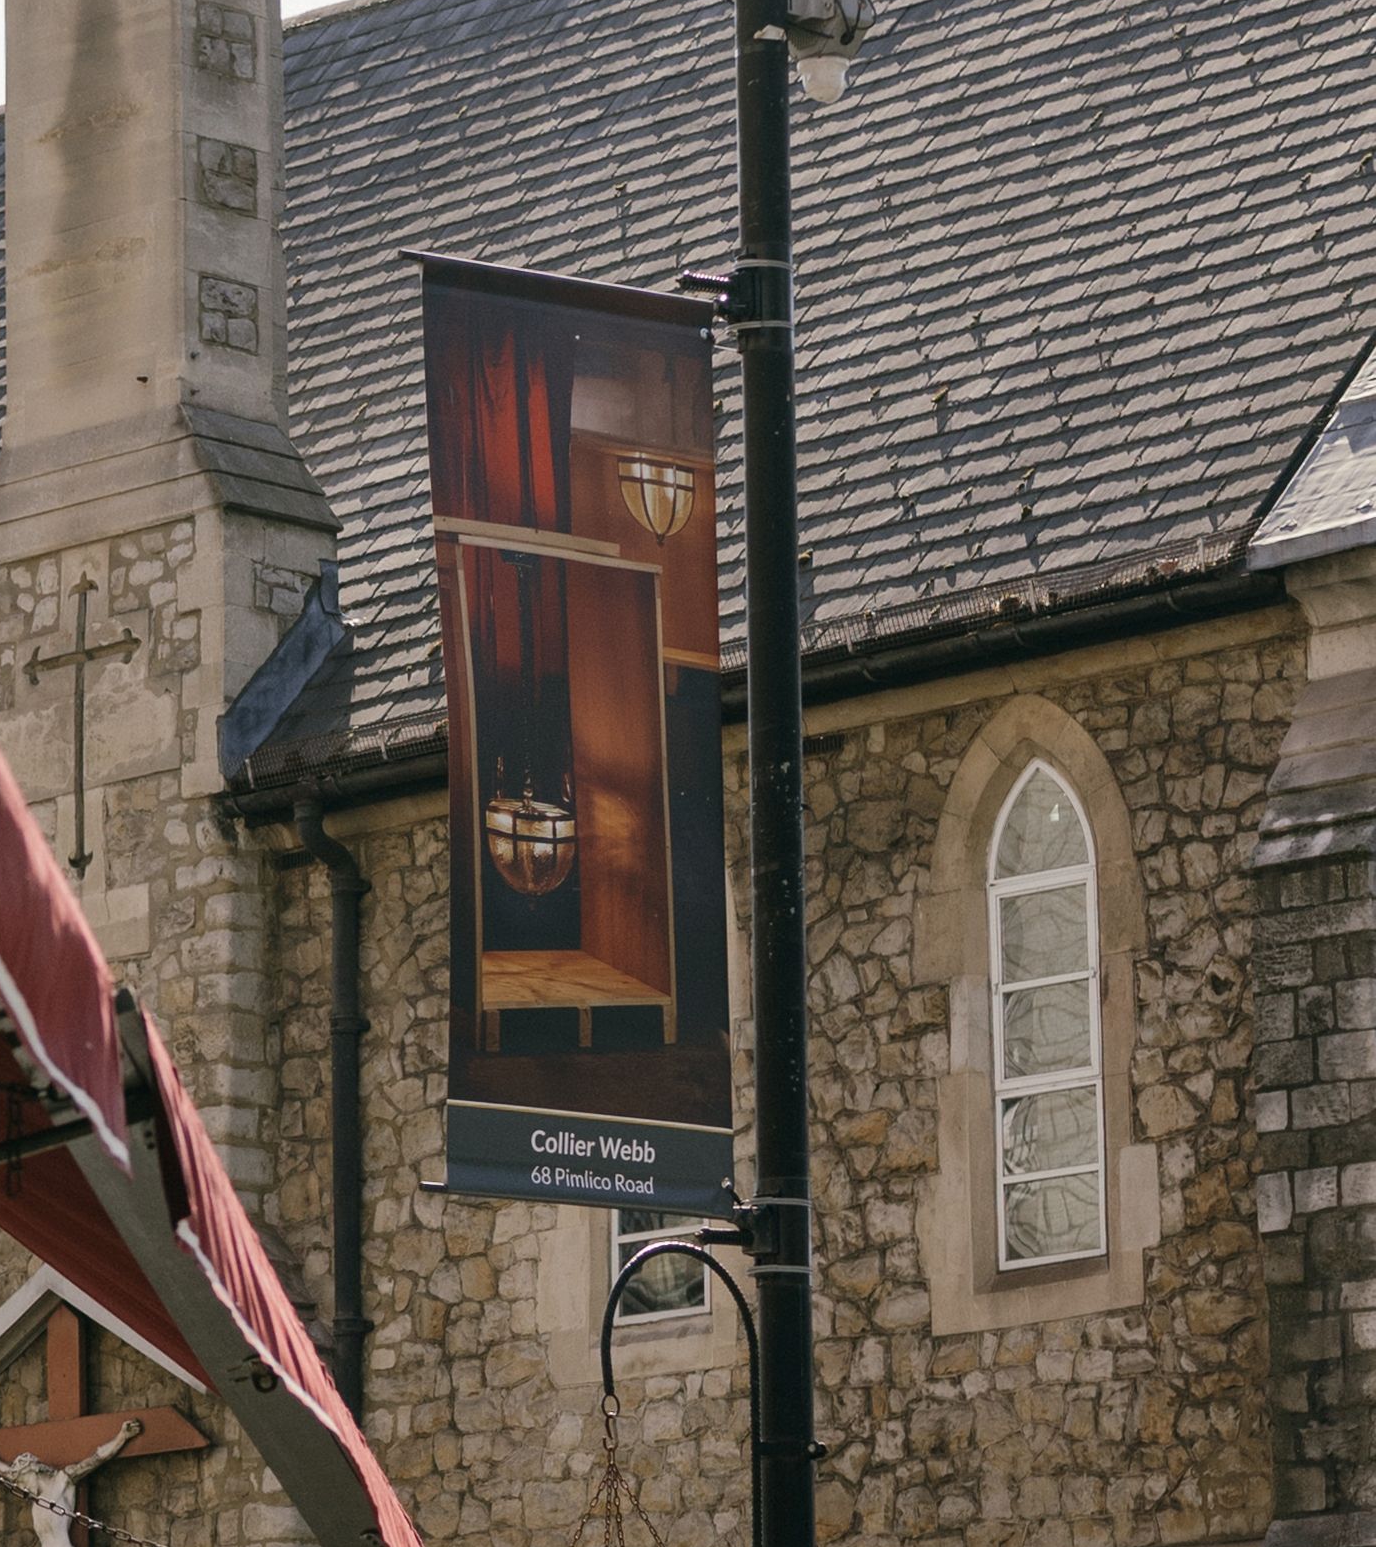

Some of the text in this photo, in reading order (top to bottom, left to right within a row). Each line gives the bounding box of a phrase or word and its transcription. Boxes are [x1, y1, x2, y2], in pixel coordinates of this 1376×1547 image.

[530, 1129, 656, 1164] Collier Webb
[530, 1166, 655, 1195] 68 Pimlico Road
